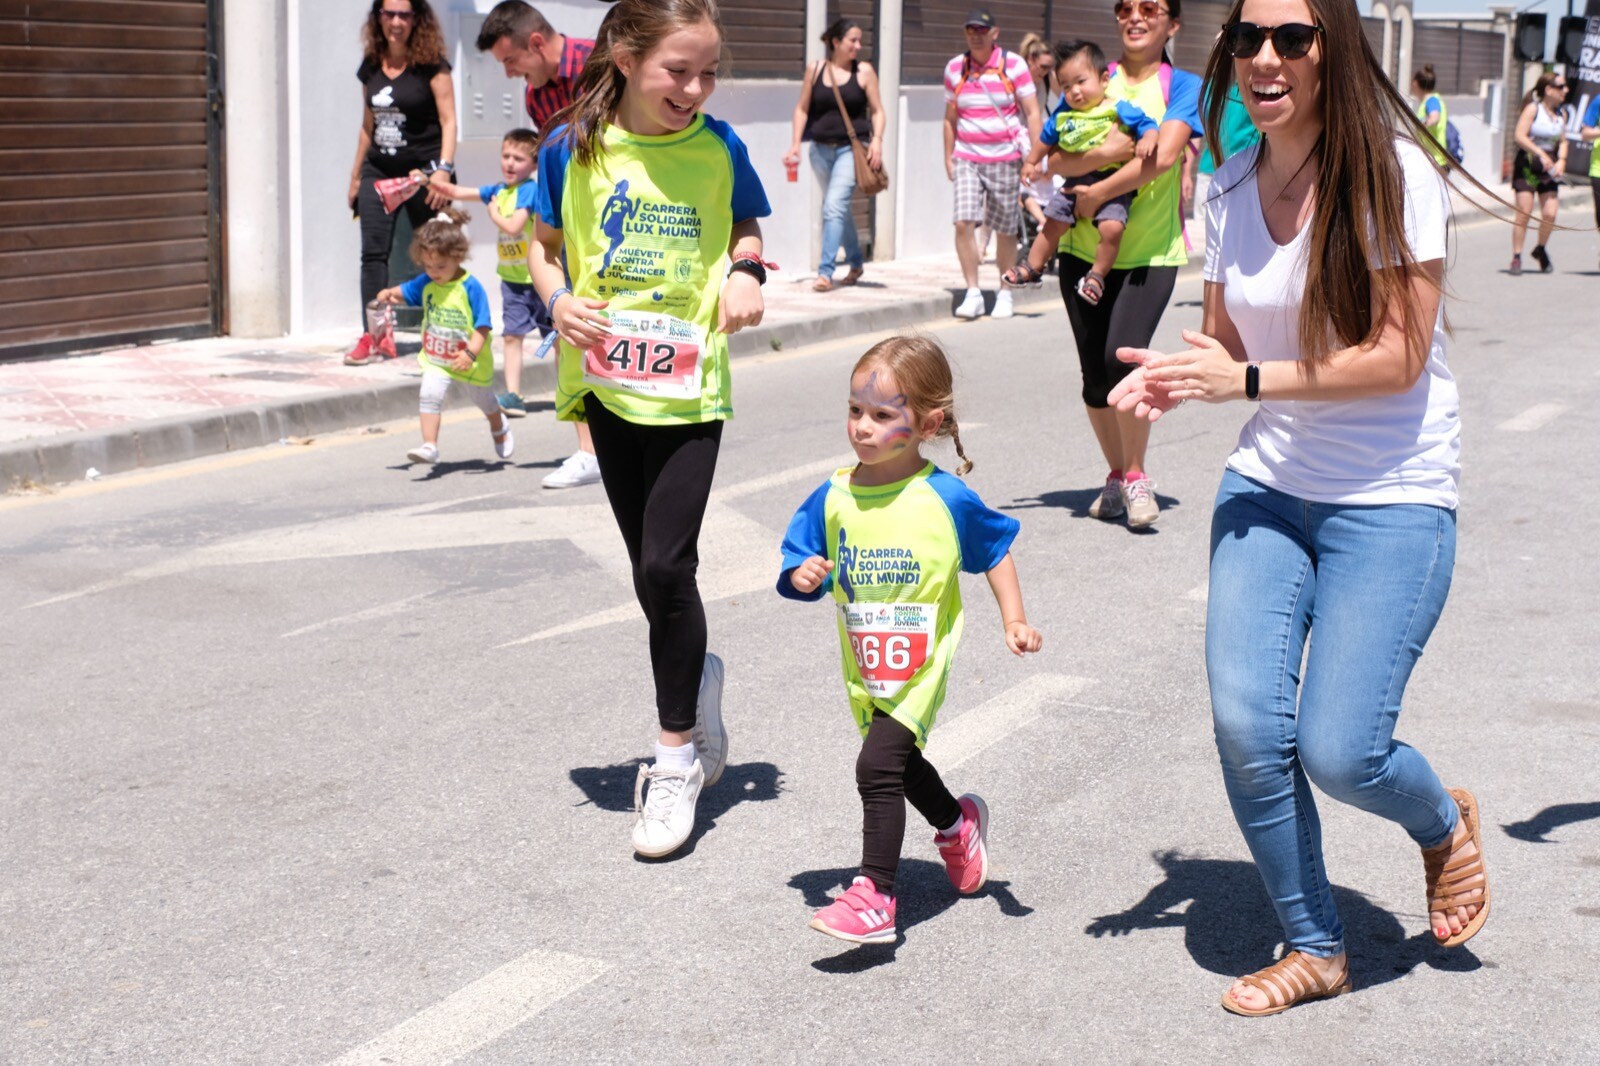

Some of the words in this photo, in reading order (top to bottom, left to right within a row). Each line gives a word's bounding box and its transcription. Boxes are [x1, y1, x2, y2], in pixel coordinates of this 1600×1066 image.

[643, 203, 697, 216] CARRERA
[639, 212, 702, 227] SOLIDARIA
[625, 222, 653, 235] LUX
[658, 225, 701, 239] MUNDI
[619, 249, 664, 259] MUÉVETE
[614, 256, 654, 267] CONTRA
[612, 264, 623, 272] EL
[625, 263, 666, 277] CÁNCER
[607, 272, 647, 283] JUVENIL
[425, 334, 459, 356] 365
[607, 339, 676, 375] 412
[860, 548, 913, 559] CARRERA
[858, 560, 921, 572] SOLIDARIA
[850, 573, 873, 585] LUX
[876, 572, 920, 585] MUNDI
[852, 634, 911, 670] 366
